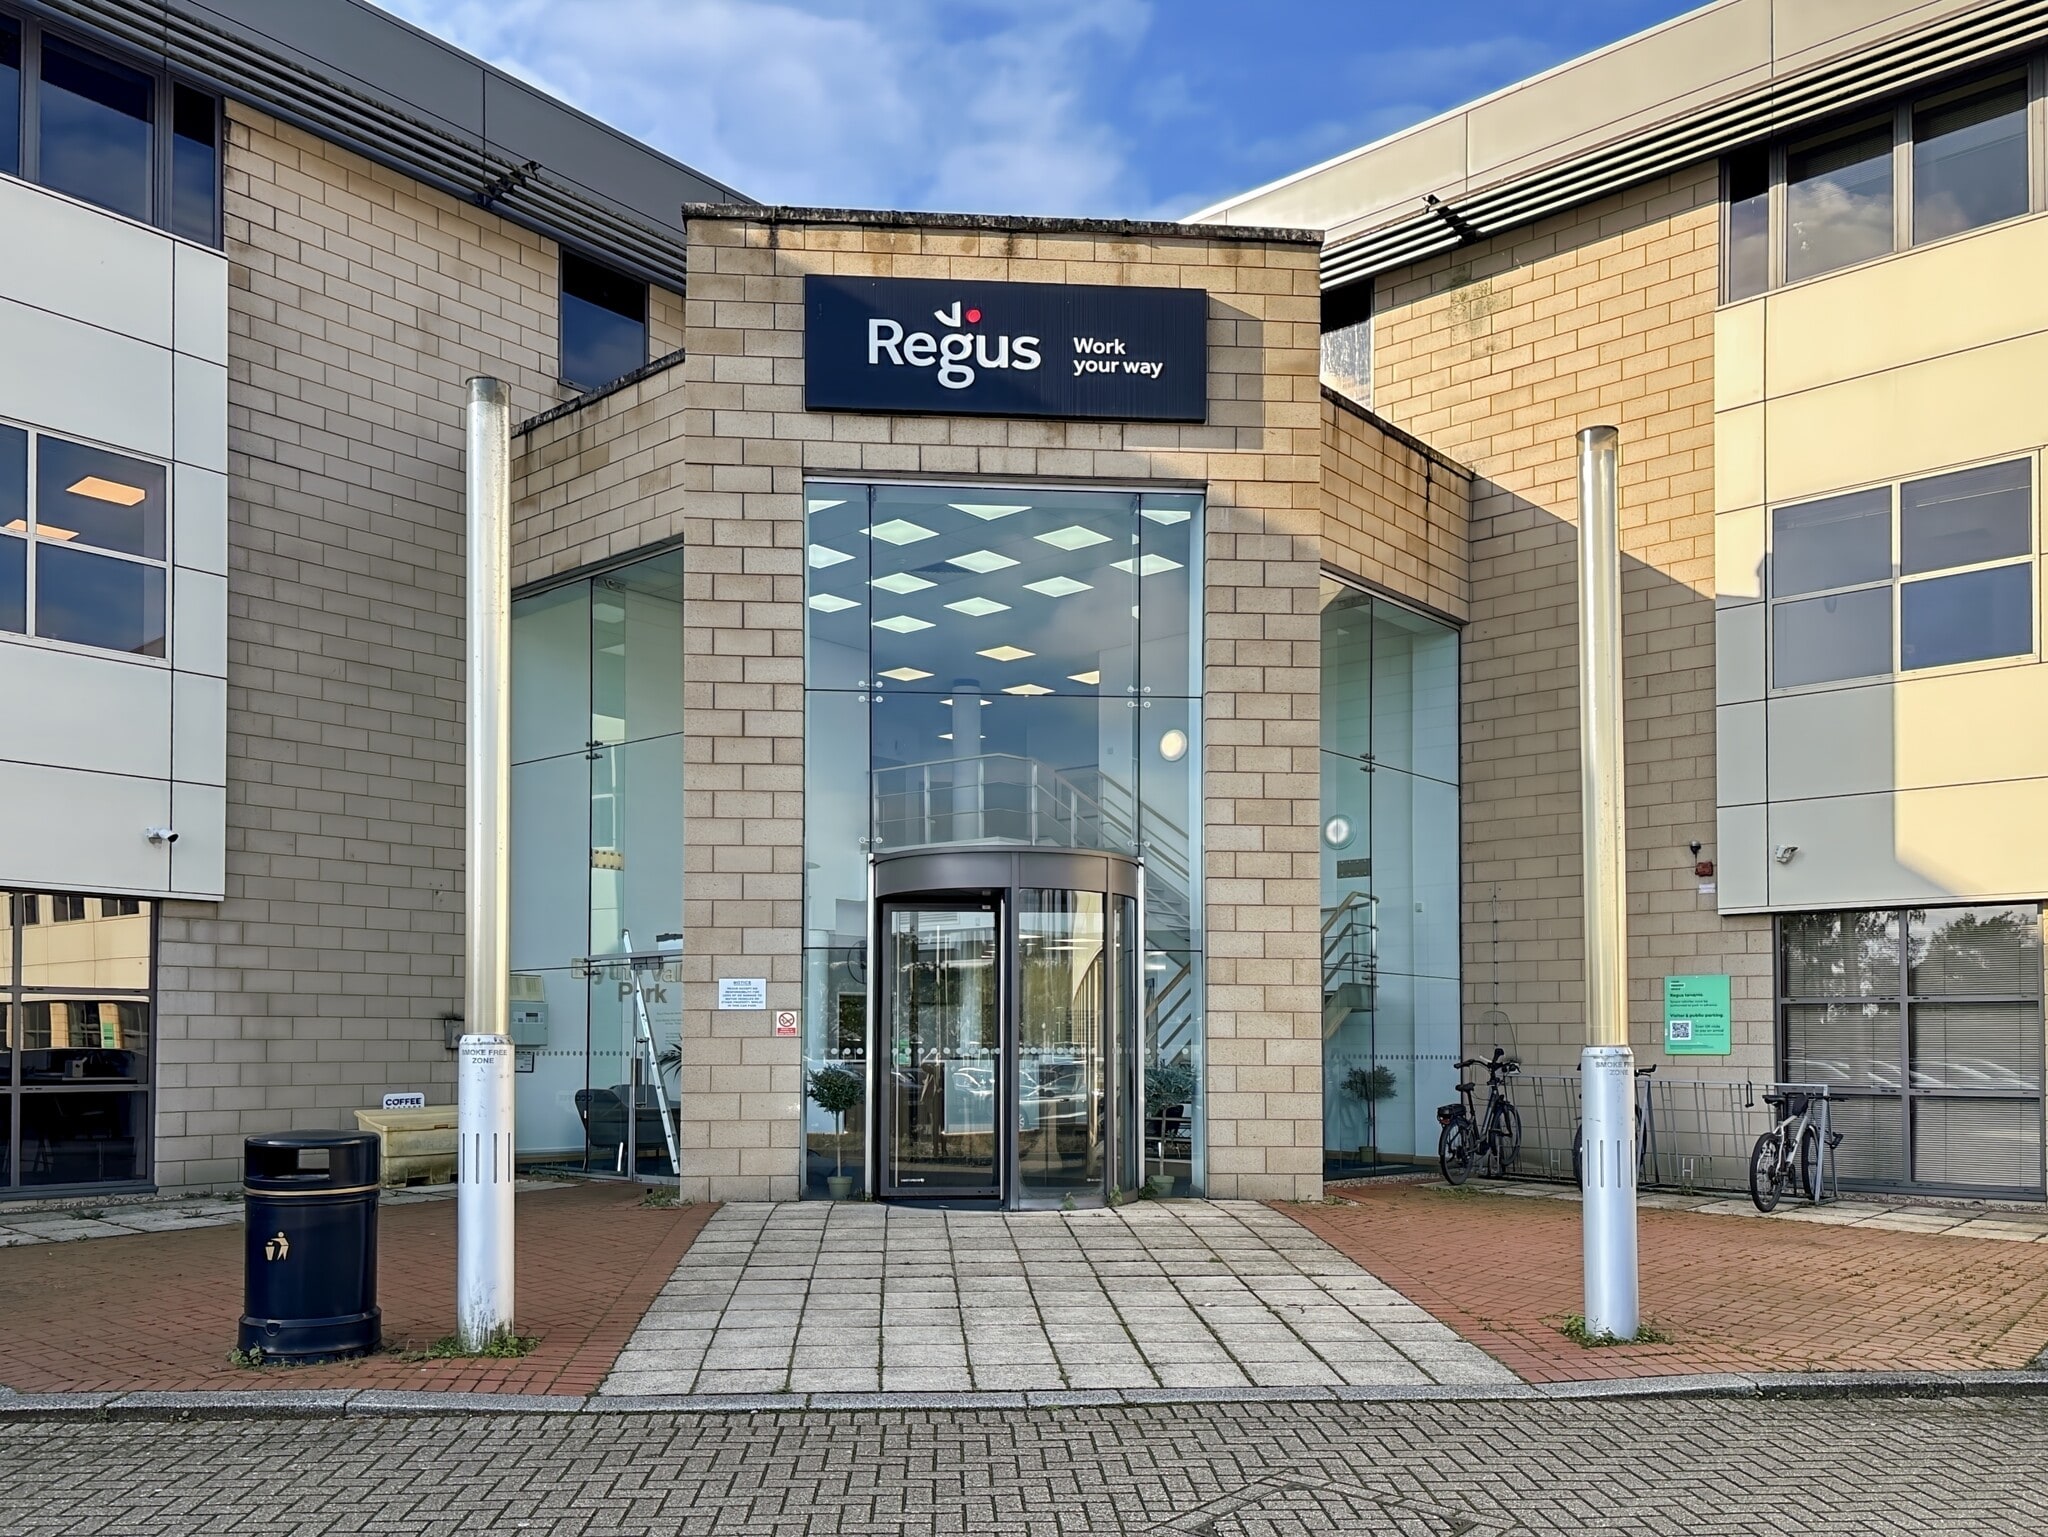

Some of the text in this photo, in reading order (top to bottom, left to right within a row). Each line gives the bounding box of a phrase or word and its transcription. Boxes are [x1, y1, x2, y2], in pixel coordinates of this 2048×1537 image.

[868, 316, 1041, 389] Regus
[1073, 336, 1126, 356] Work
[1073, 359, 1163, 379] your way
[386, 1098, 422, 1106] COFFEE
